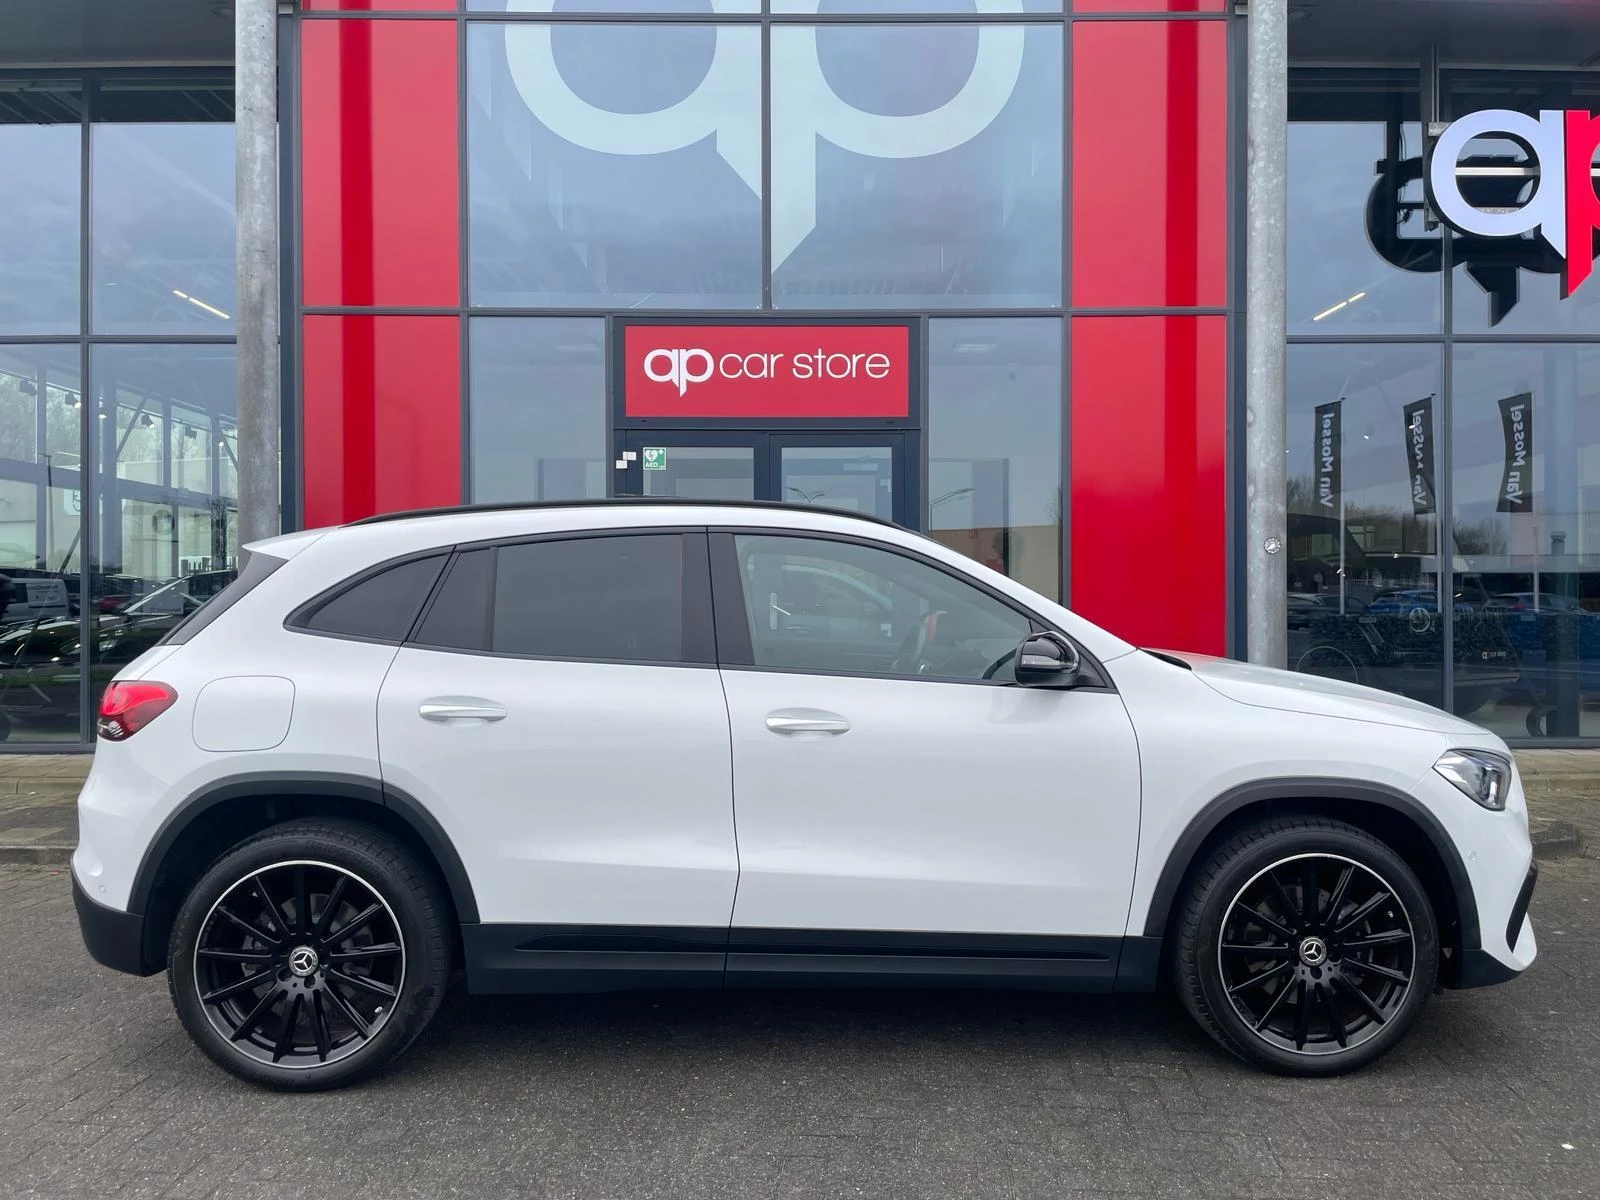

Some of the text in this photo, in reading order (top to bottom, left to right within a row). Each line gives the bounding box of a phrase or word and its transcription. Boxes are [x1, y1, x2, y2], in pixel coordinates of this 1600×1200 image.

[1431, 108, 1600, 299] a
[643, 348, 891, 398] ap car store
